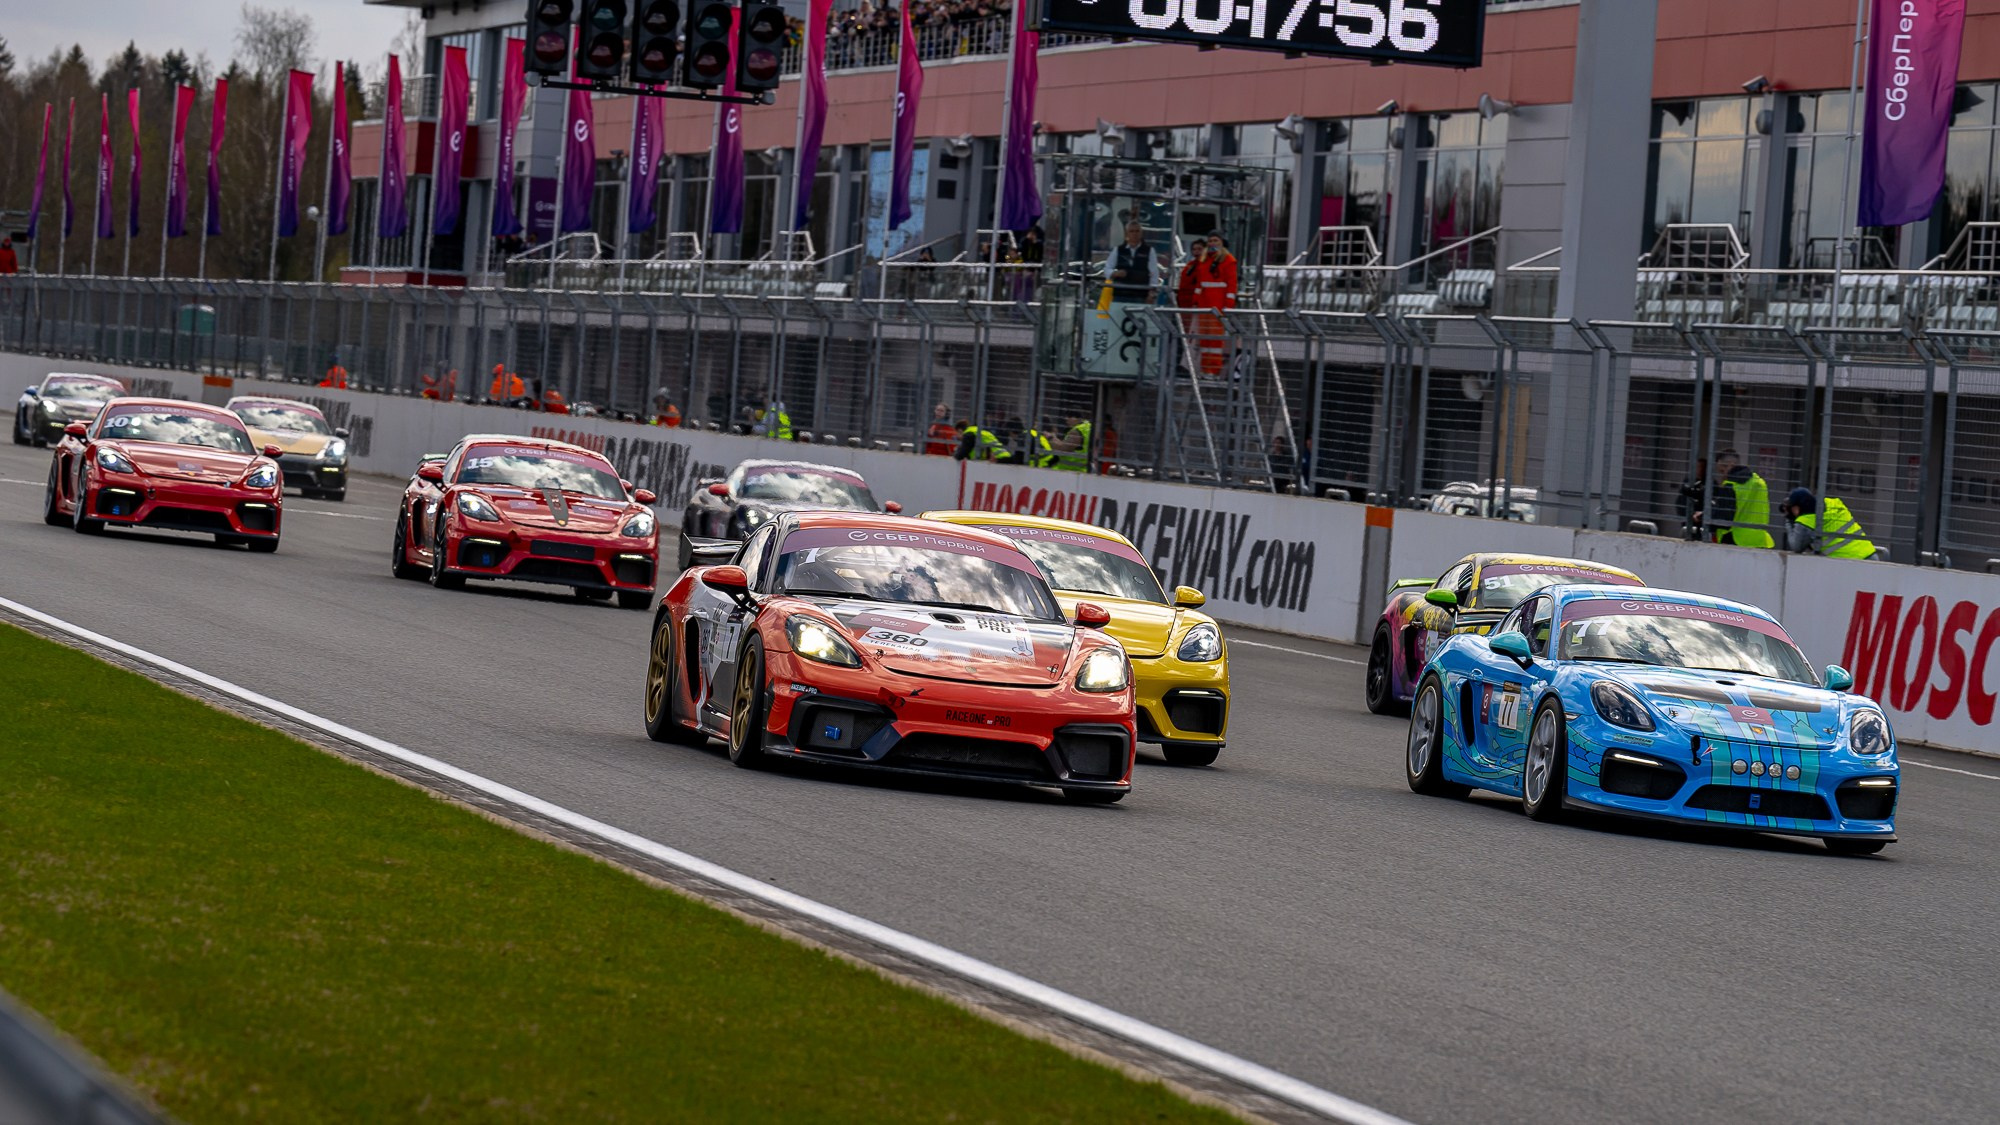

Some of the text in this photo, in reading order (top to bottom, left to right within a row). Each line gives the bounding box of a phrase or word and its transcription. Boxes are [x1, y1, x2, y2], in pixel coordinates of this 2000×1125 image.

[104, 416, 129, 429] 10
[467, 458, 493, 470] 15
[873, 533, 985, 554] СБЕР Первый
[998, 527, 1096, 545] СБЕР Первый
[1536, 565, 1613, 580] СБЕР Первый
[1484, 575, 1514, 591] 51
[1643, 603, 1745, 624] СБЕР Первый
[1572, 619, 1614, 638] 77
[874, 631, 929, 647] 360
[1841, 590, 2000, 726] MOSC
[1501, 694, 1516, 727] 77
